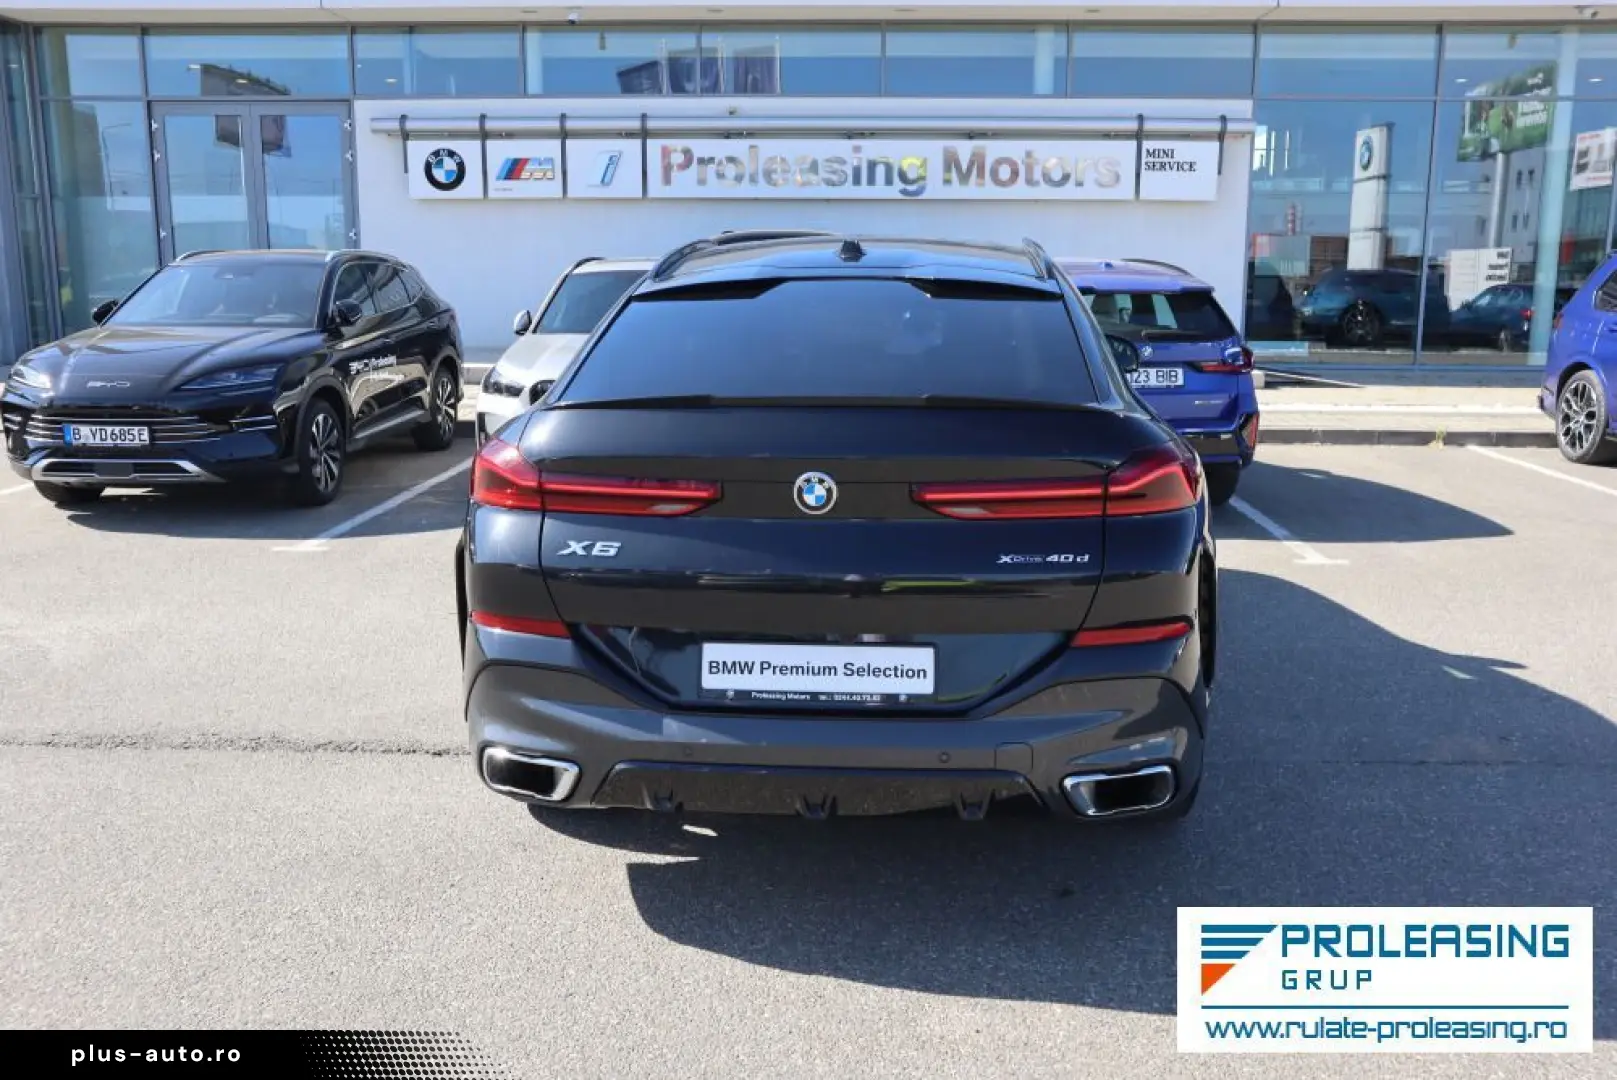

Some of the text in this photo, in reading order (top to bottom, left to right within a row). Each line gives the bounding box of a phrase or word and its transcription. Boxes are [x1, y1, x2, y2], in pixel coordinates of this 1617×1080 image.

[1145, 148, 1176, 159] MINI
[660, 145, 1122, 198] Proleasing Motors
[1144, 161, 1198, 172] SERVICE
[1155, 369, 1178, 384] BIB
[556, 540, 622, 557] X6
[708, 660, 928, 680] BMW Premium Selection
